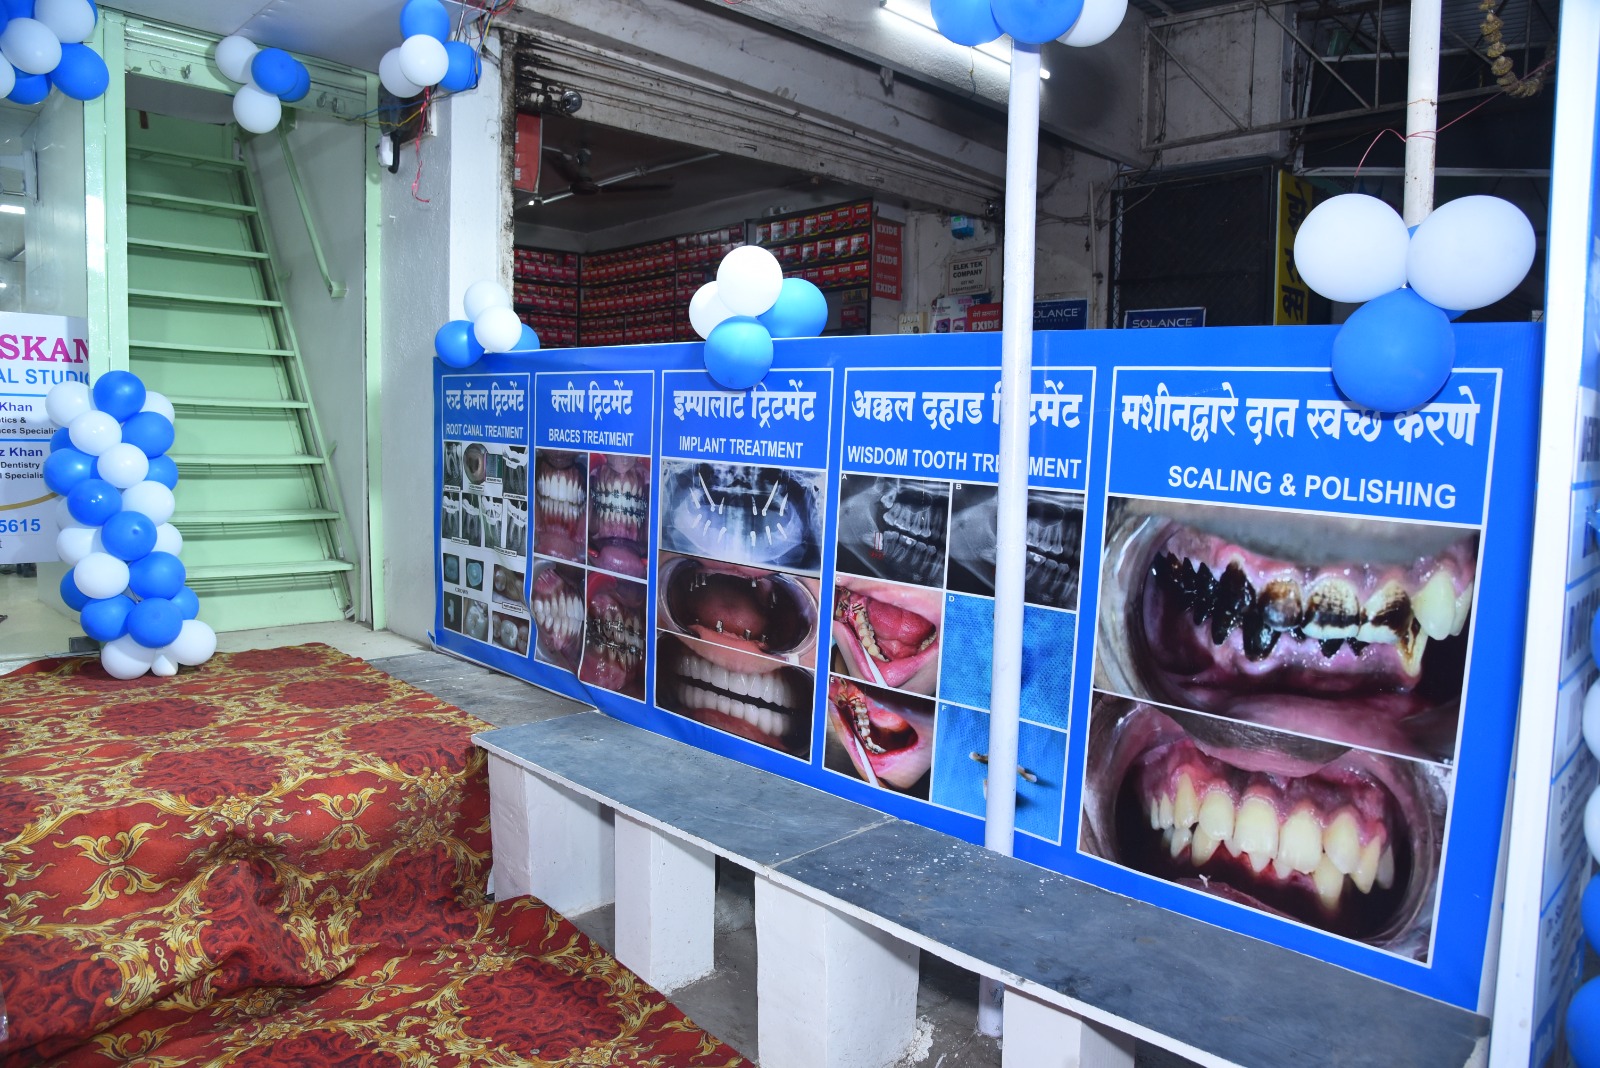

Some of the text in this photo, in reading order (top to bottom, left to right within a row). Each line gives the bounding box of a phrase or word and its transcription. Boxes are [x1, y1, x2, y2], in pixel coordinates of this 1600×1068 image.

[877, 224, 898, 236] EXIDE
[877, 254, 898, 266] EXIDE
[953, 261, 983, 271] ELEK TEK
[953, 269, 983, 278] COMPANY
[875, 282, 897, 295] EXIDE
[1033, 308, 1079, 319] OLANCE
[972, 319, 1000, 331] EXIDE
[1132, 317, 1193, 329] SOLANCE
[446, 389, 461, 410] रुट
[490, 380, 525, 417] ट्रिटमेंट
[551, 379, 634, 421] क्लीप ट्रिटमेंट
[750, 379, 817, 429] ट्रिटमेंट
[851, 389, 917, 423] अक्कल
[921, 391, 985, 431] दहाड
[0, 416, 27, 424] tics &
[1245, 397, 1299, 446] दात
[446, 423, 524, 440] ROOT CANAL TREATMENT
[548, 428, 634, 447] BRACES TREATMENT
[9, 447, 43, 457] Khan
[679, 435, 803, 459] IMPLANT TREATMENT
[1, 461, 40, 470] Dentistry
[847, 445, 1082, 480] WISDOM TOOTH TRMENT
[4, 472, 44, 480] Specialis
[1167, 465, 1457, 510] SCALING & POLISHING
[0, 518, 41, 533] 5615
